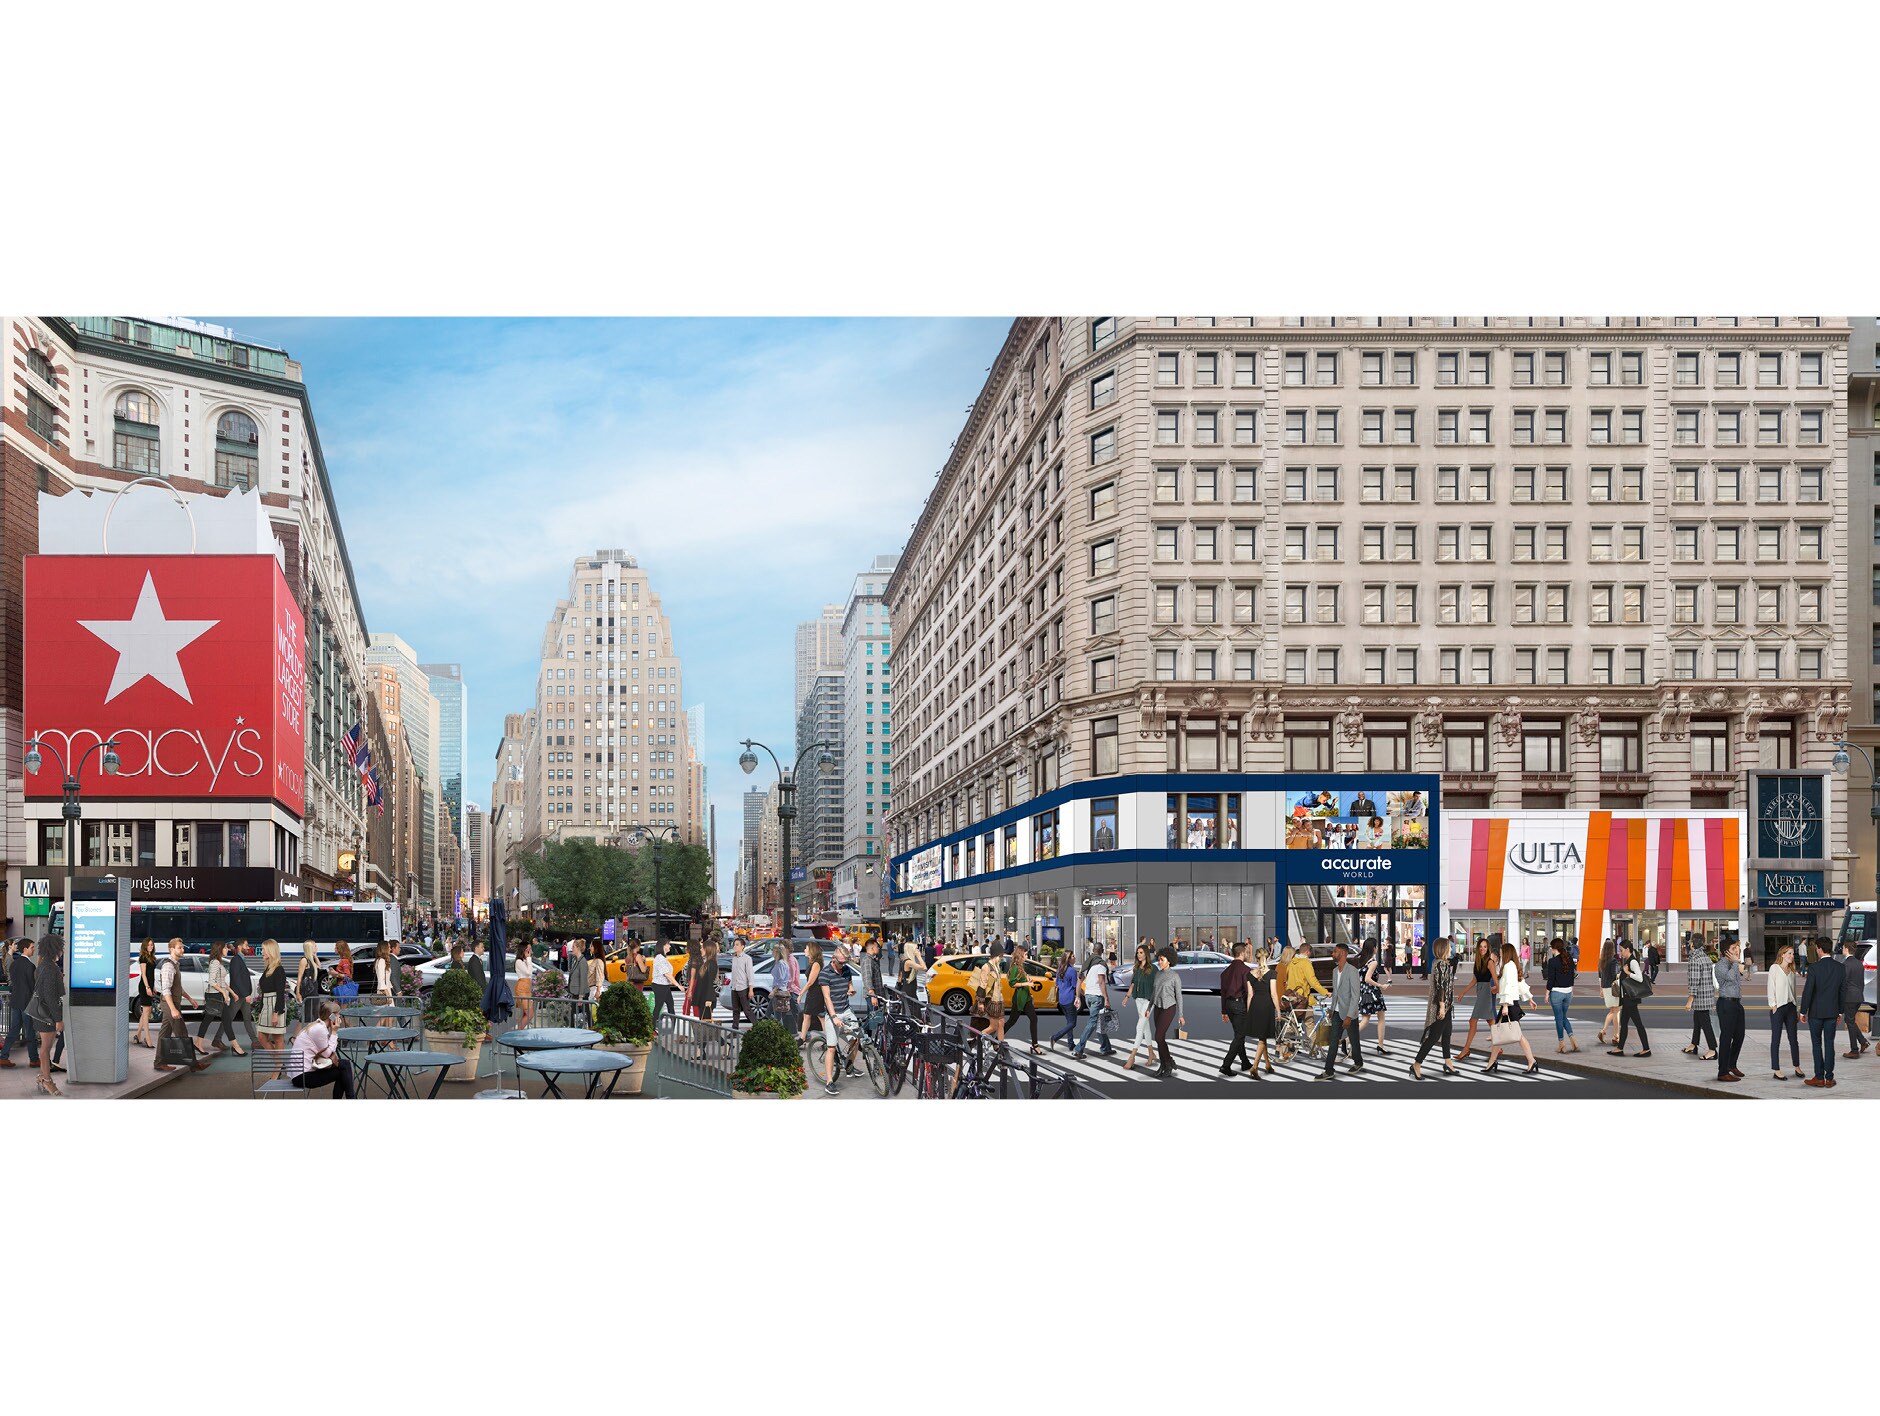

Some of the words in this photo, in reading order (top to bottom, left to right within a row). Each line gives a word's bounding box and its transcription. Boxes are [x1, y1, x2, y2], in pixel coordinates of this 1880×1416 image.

[284, 608, 297, 649] THE
[277, 654, 302, 711] LARGEST
[281, 691, 300, 736] STORE
[1321, 856, 1392, 870] accurate
[1519, 842, 1582, 864] ULTA
[131, 875, 173, 893] unglass
[175, 875, 195, 890] hut
[1764, 873, 1806, 888] MERCY
[1768, 884, 1817, 896] COLLEGE
